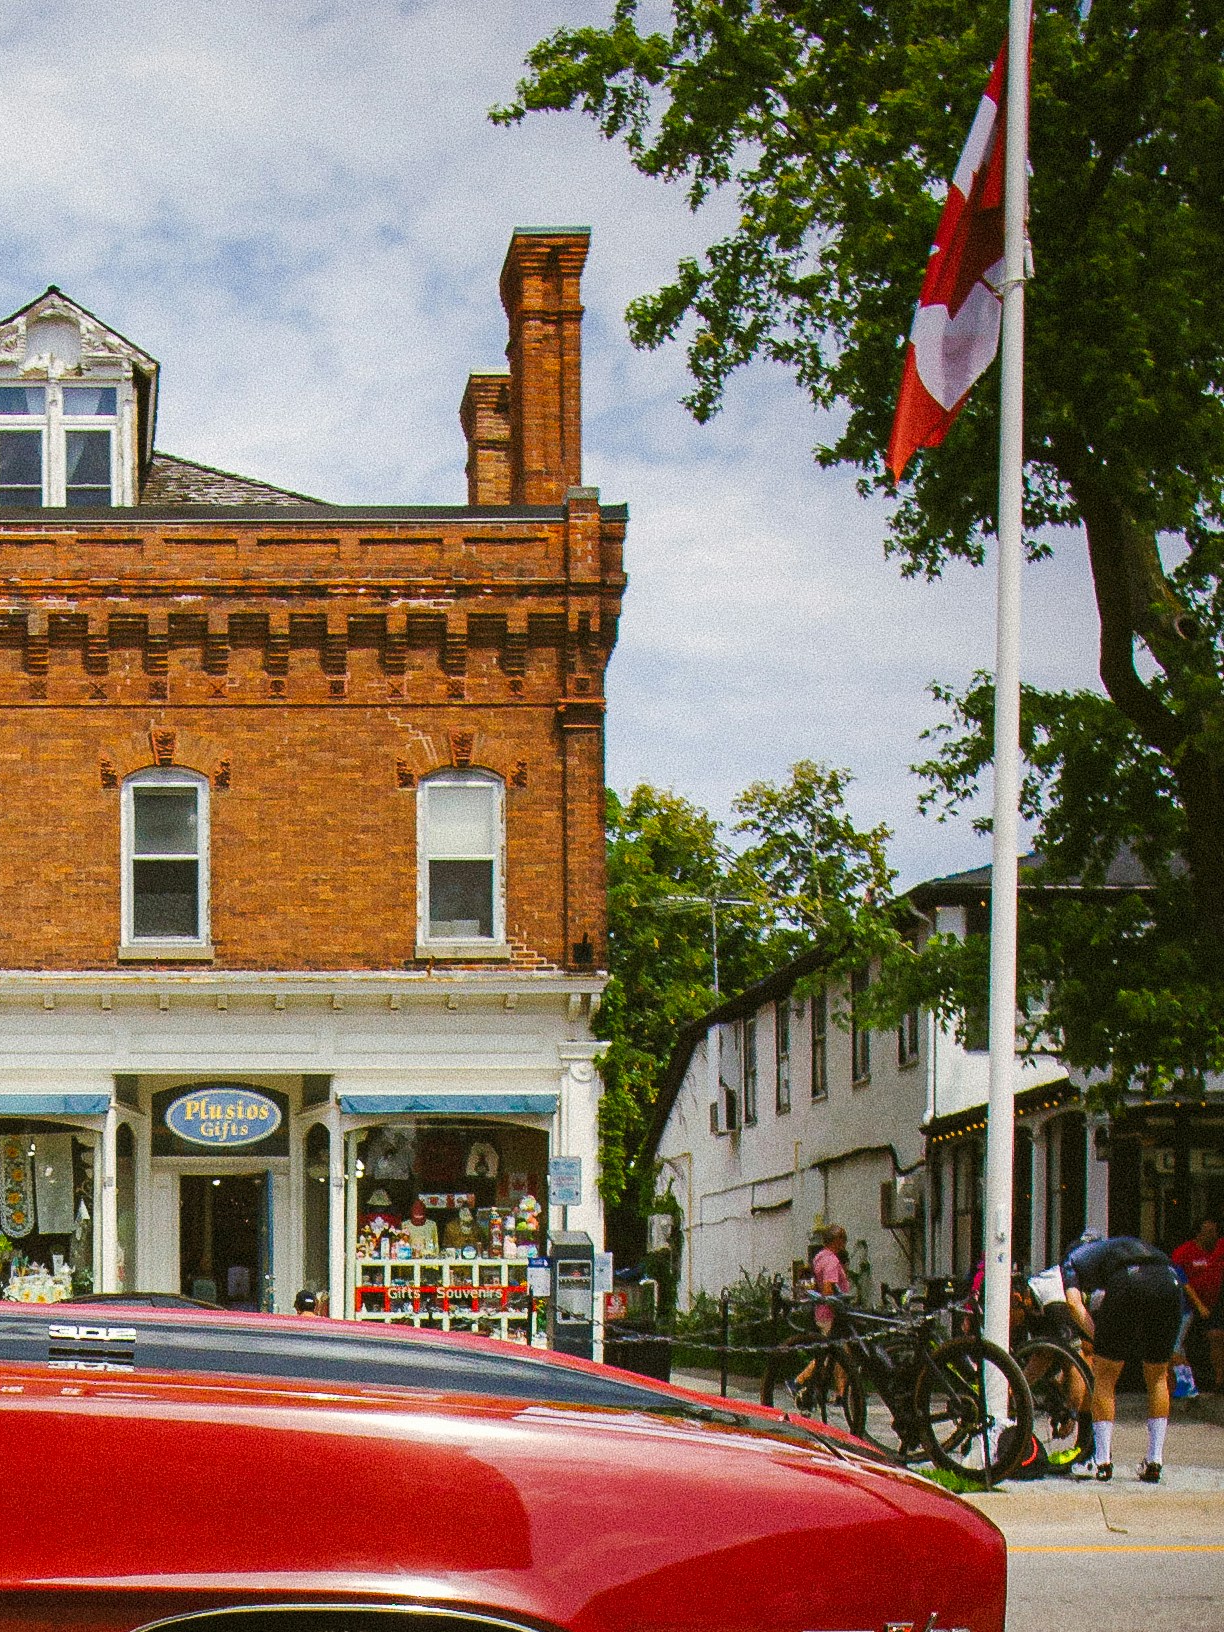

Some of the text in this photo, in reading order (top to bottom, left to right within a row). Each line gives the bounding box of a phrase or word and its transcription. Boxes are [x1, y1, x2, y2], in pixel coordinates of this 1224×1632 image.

[184, 1098, 270, 1120] Plusios
[200, 1120, 249, 1142] Gifts
[387, 1286, 504, 1299] Gifts Souvenirs
